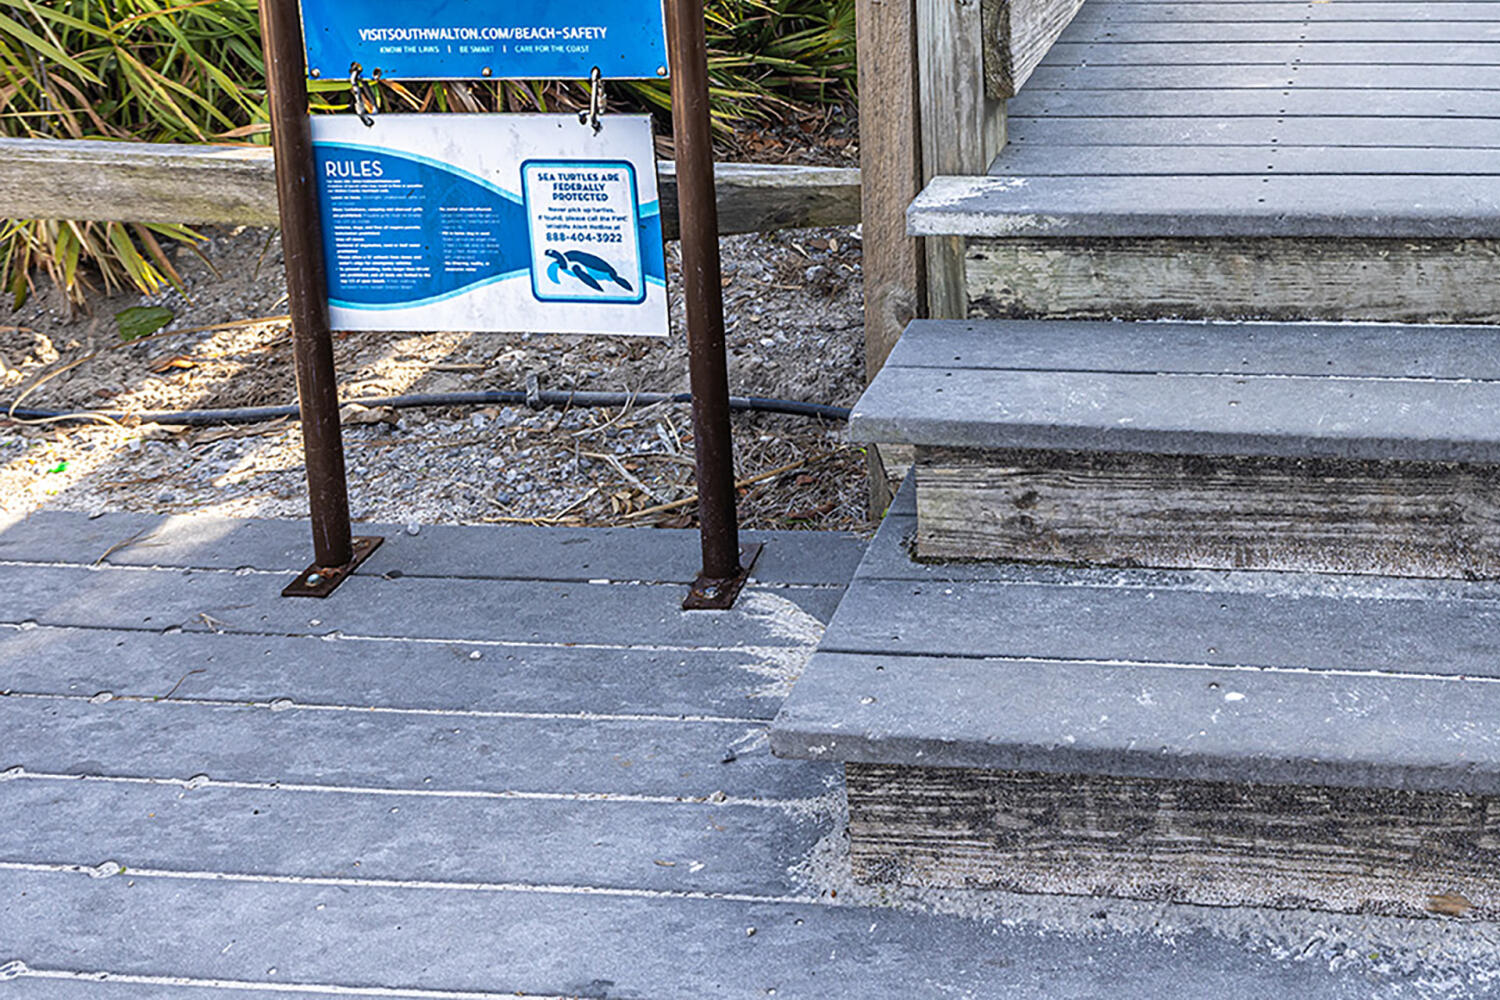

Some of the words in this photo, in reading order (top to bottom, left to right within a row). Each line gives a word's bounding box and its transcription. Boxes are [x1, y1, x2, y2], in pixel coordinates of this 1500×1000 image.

[358, 27, 607, 41] VISITSOUTHWALTON.COM/BEACH-SAFETY
[325, 160, 383, 177] RULES
[537, 173, 556, 181] SEA
[557, 172, 599, 182] TURTLES
[601, 173, 620, 182] ARE
[553, 182, 606, 191] FEDERALLY
[552, 193, 609, 202] PROTECTED
[546, 232, 622, 242] 888-404-3922
